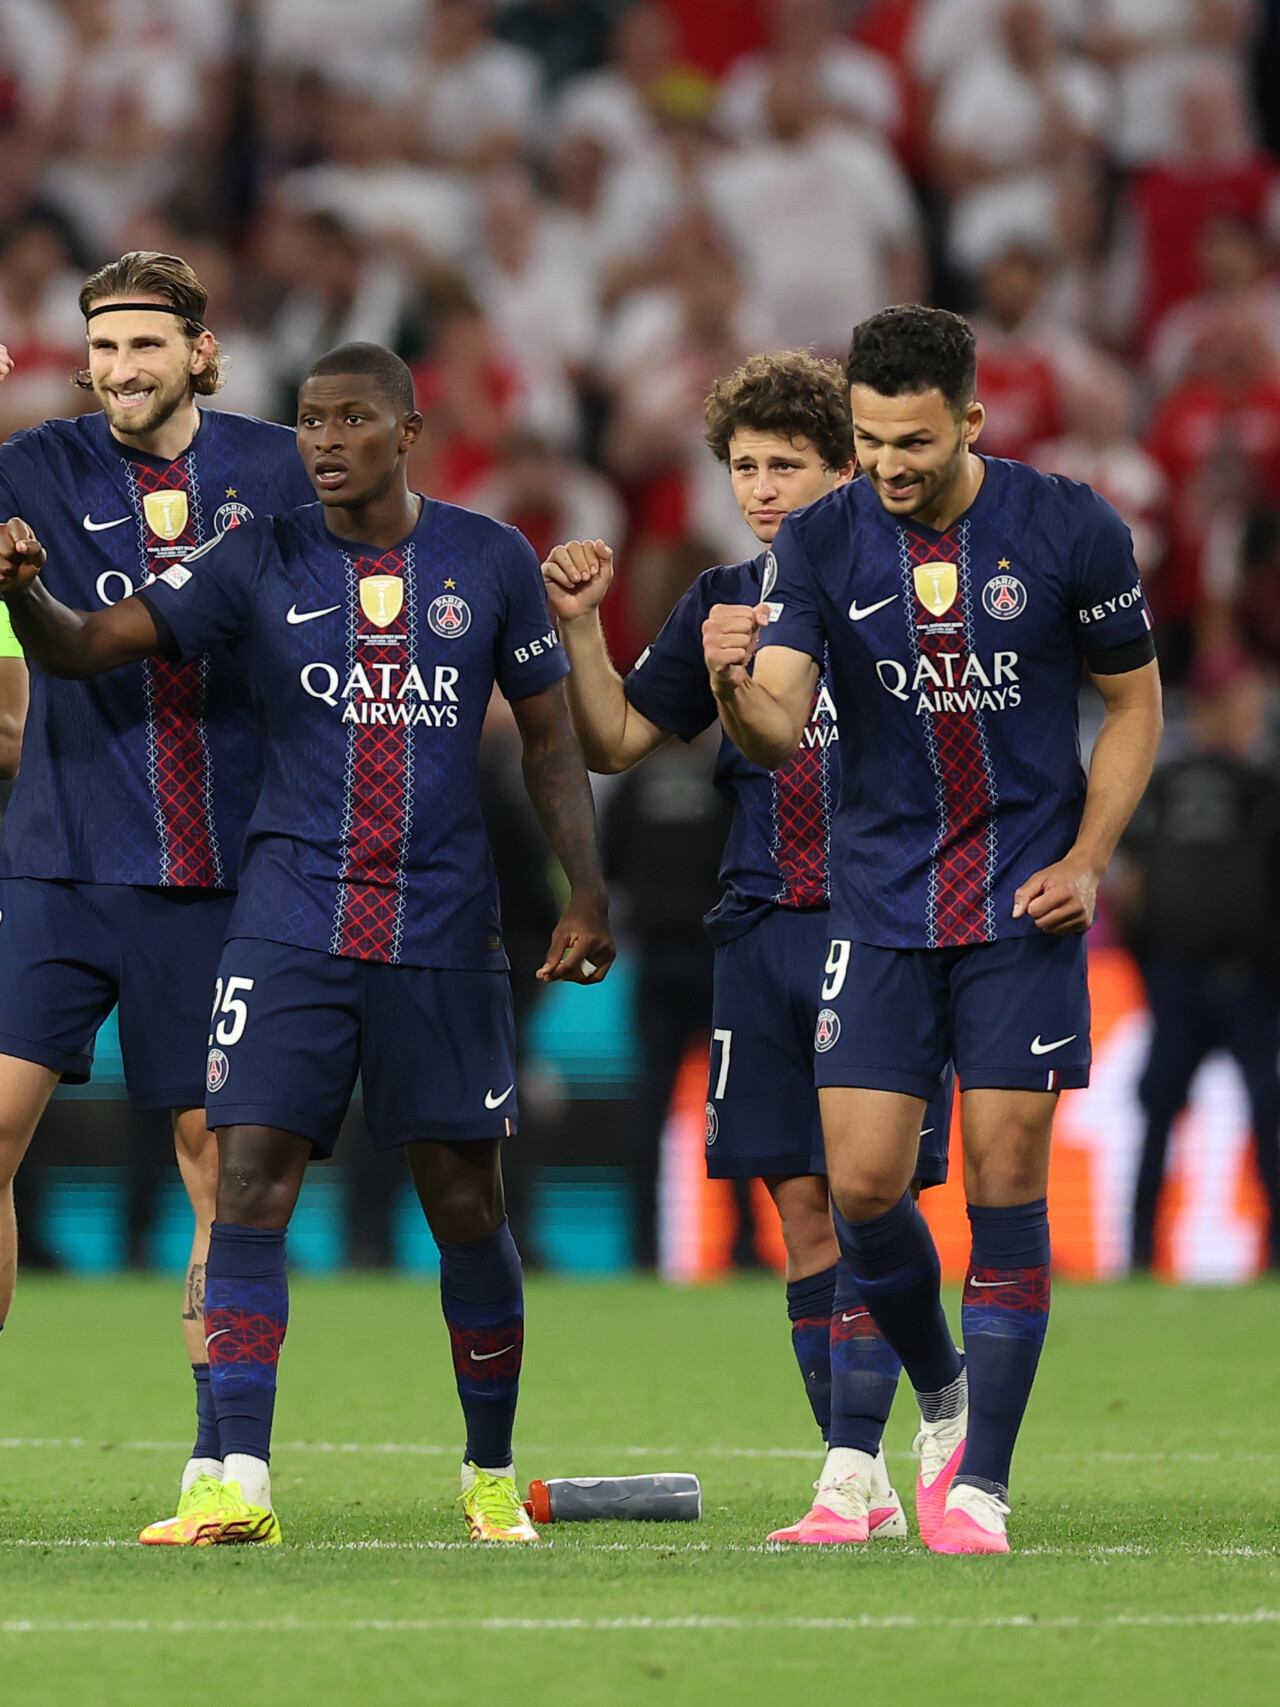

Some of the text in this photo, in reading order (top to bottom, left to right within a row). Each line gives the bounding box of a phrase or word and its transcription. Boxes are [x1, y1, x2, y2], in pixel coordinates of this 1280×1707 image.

[220, 504, 248, 516] PARIS
[989, 577, 1020, 589] PARIS
[435, 597, 466, 609] PARIS
[300, 662, 460, 707] QATAR
[875, 651, 1020, 702] QATAR
[341, 701, 458, 728] AIRWAYS
[915, 684, 1022, 716] AIRWAYS
[822, 939, 851, 1001] 9
[710, 1028, 733, 1100] 7
